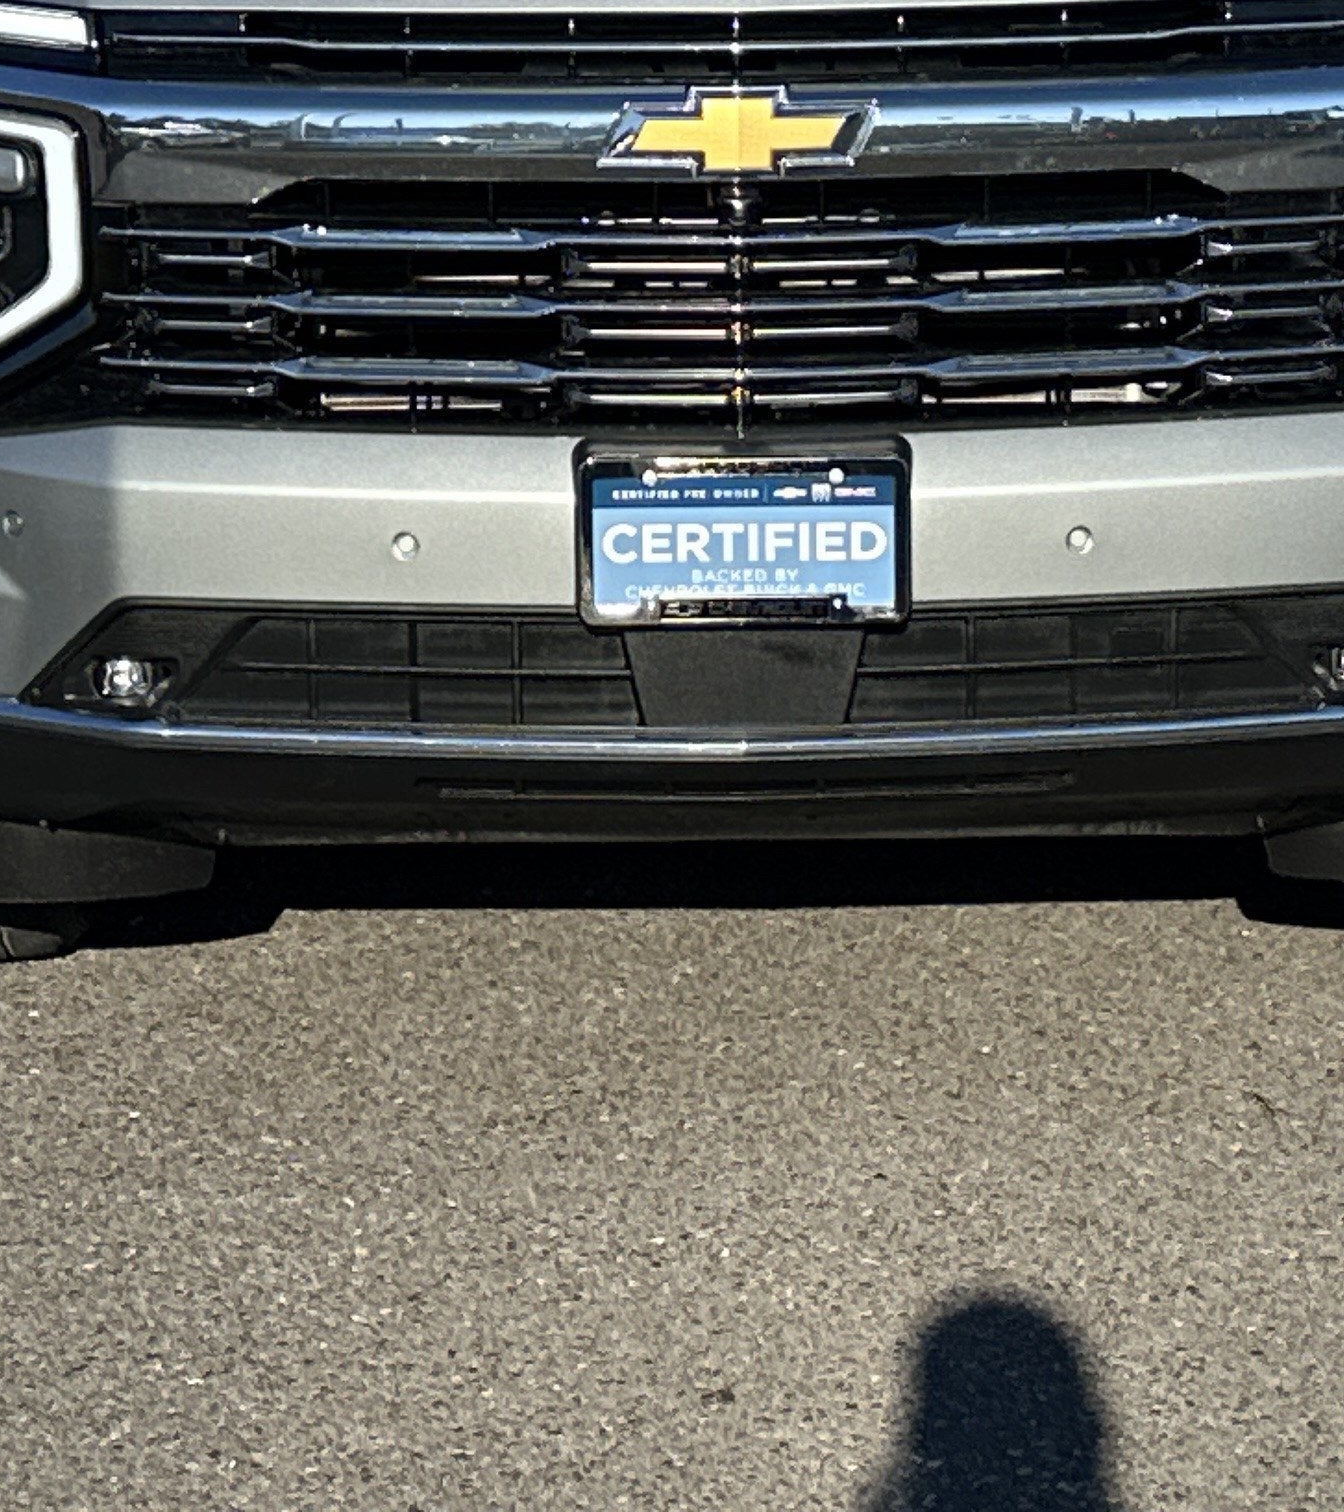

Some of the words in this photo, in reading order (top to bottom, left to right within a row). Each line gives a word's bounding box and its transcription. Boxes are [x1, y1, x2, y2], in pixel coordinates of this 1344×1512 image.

[601, 520, 888, 564] CERTIFIED
[691, 568, 767, 583] BACKED
[774, 568, 799, 582] BY
